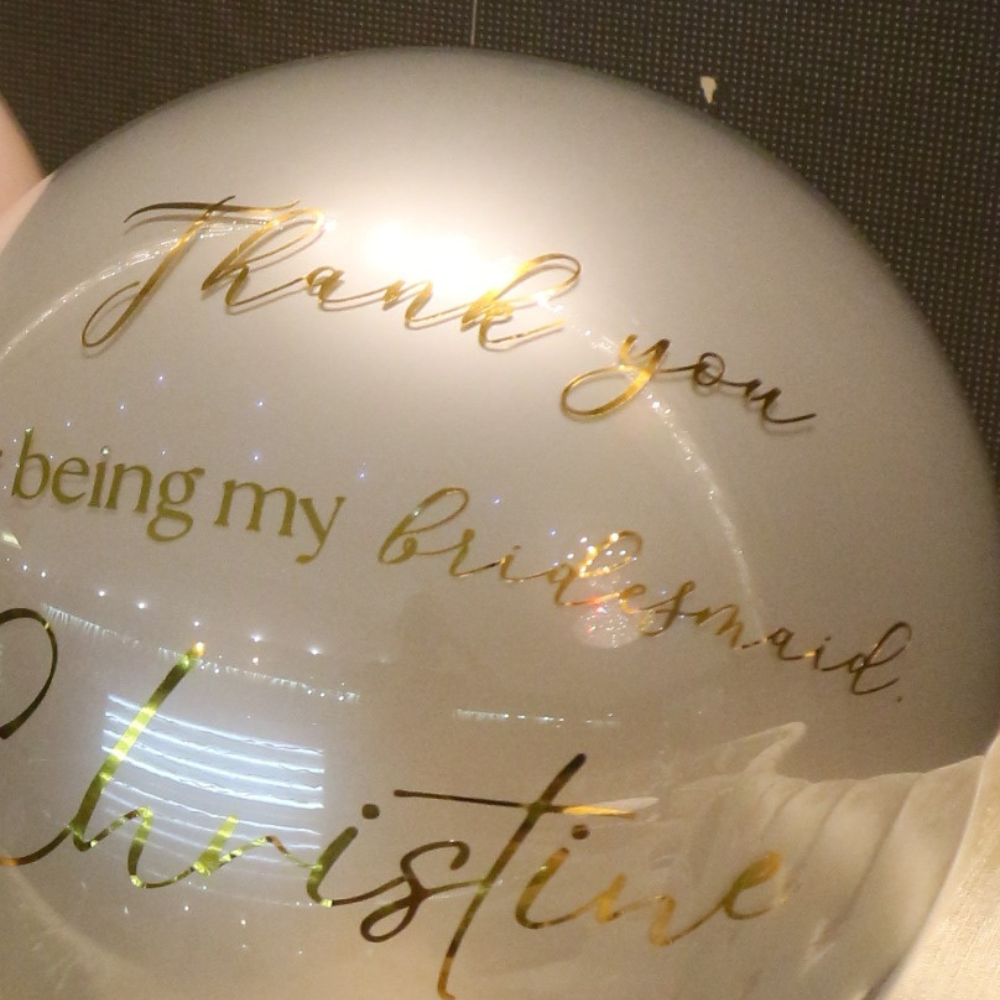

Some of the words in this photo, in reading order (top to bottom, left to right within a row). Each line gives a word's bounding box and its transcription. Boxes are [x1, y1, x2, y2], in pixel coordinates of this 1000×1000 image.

[80, 194, 582, 348] Thank
[561, 330, 816, 425] you
[10, 427, 205, 542] being
[215, 473, 345, 565] my
